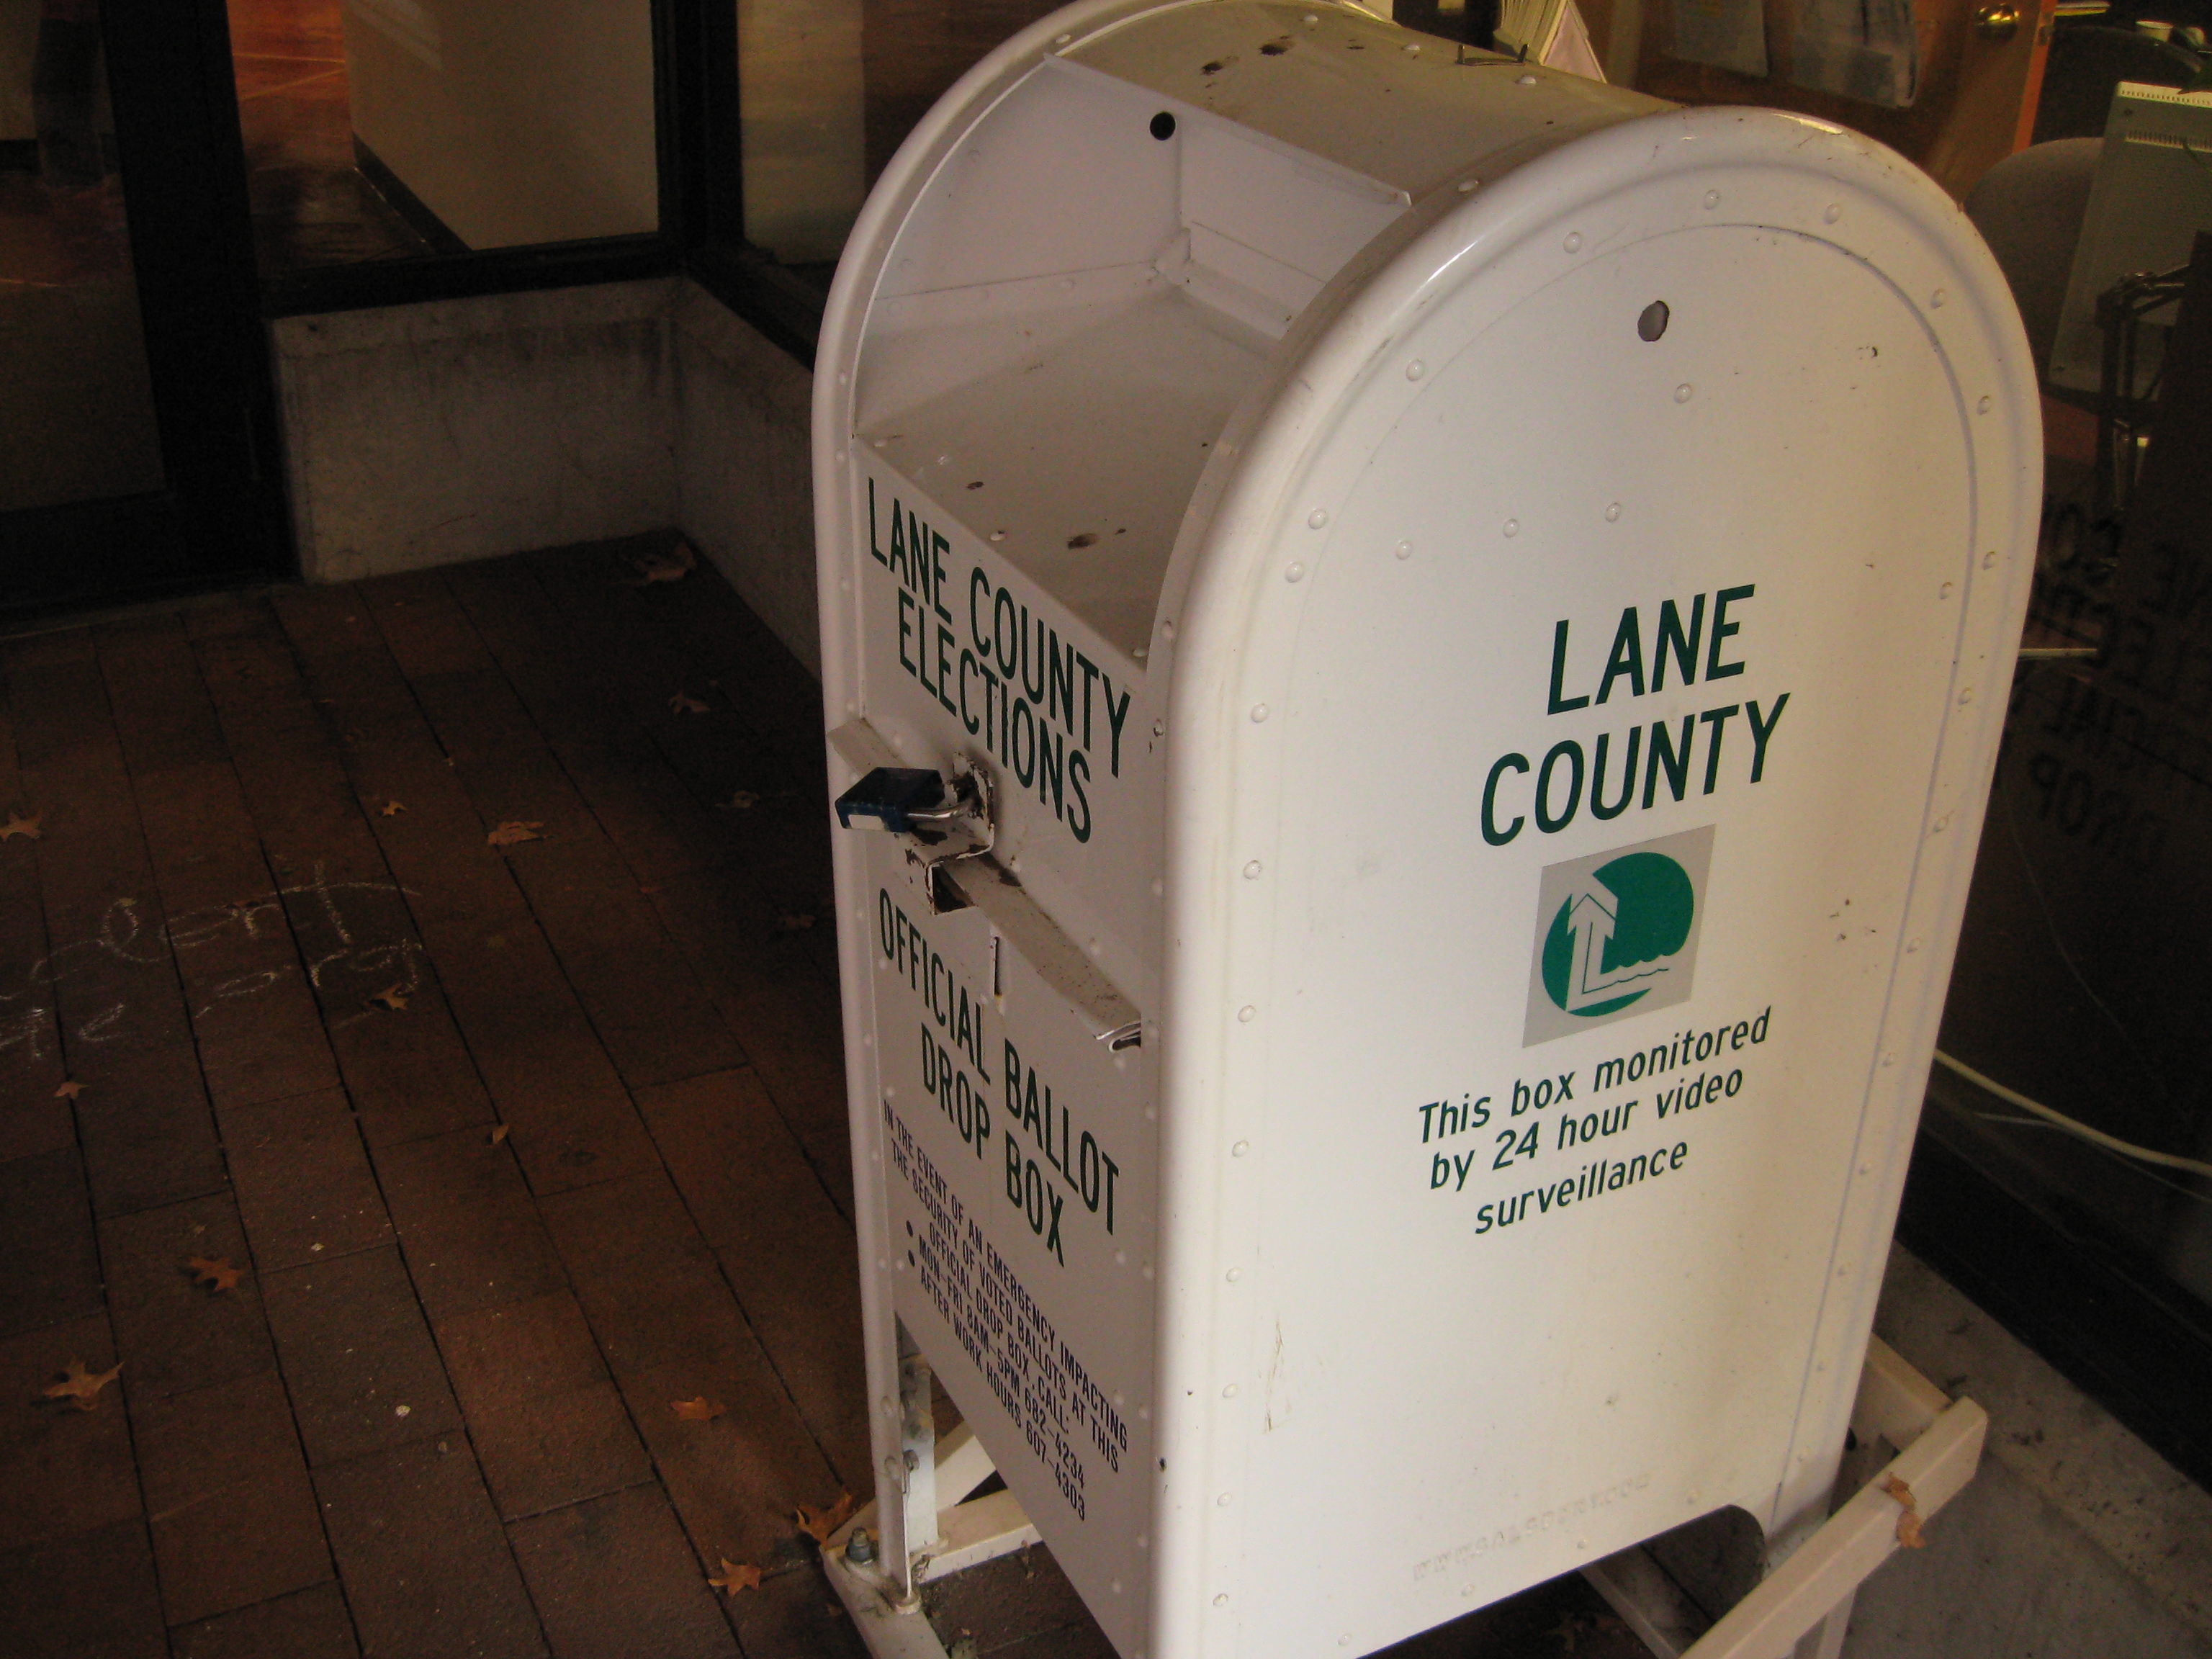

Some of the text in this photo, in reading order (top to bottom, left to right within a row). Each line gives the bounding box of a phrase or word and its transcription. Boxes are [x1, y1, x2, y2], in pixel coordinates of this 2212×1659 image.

[868, 477, 1131, 778] LANE COUNTY
[898, 587, 1091, 843] ELECTIONS
[1547, 583, 1755, 716] LANE
[1480, 692, 1791, 848] COUNTY
[879, 888, 1120, 1235] OFFICIAL BALLOT
[921, 1022, 1064, 1267] DROP BOX
[1419, 1005, 1772, 1143] This box monitored
[1430, 1068, 1744, 1192] by 24 hour video
[884, 1100, 1127, 1452] IN THE EVENT OF AN EMERGENCY IMPACTING
[891, 1138, 1119, 1473] THE SECURITY OF VOTED BALLOTS AT THIS
[1474, 1141, 1689, 1235] surveillance
[919, 1233, 963, 1315] MON-FRI
[1025, 1387, 1084, 1490] 682-4234
[920, 1265, 1085, 1521] AFTER WORK HOURS 607-4303
[929, 1222, 973, 1300] OFFICIAL
[976, 1287, 1003, 1339] DROP
[1038, 1375, 1069, 1434] CALL:
